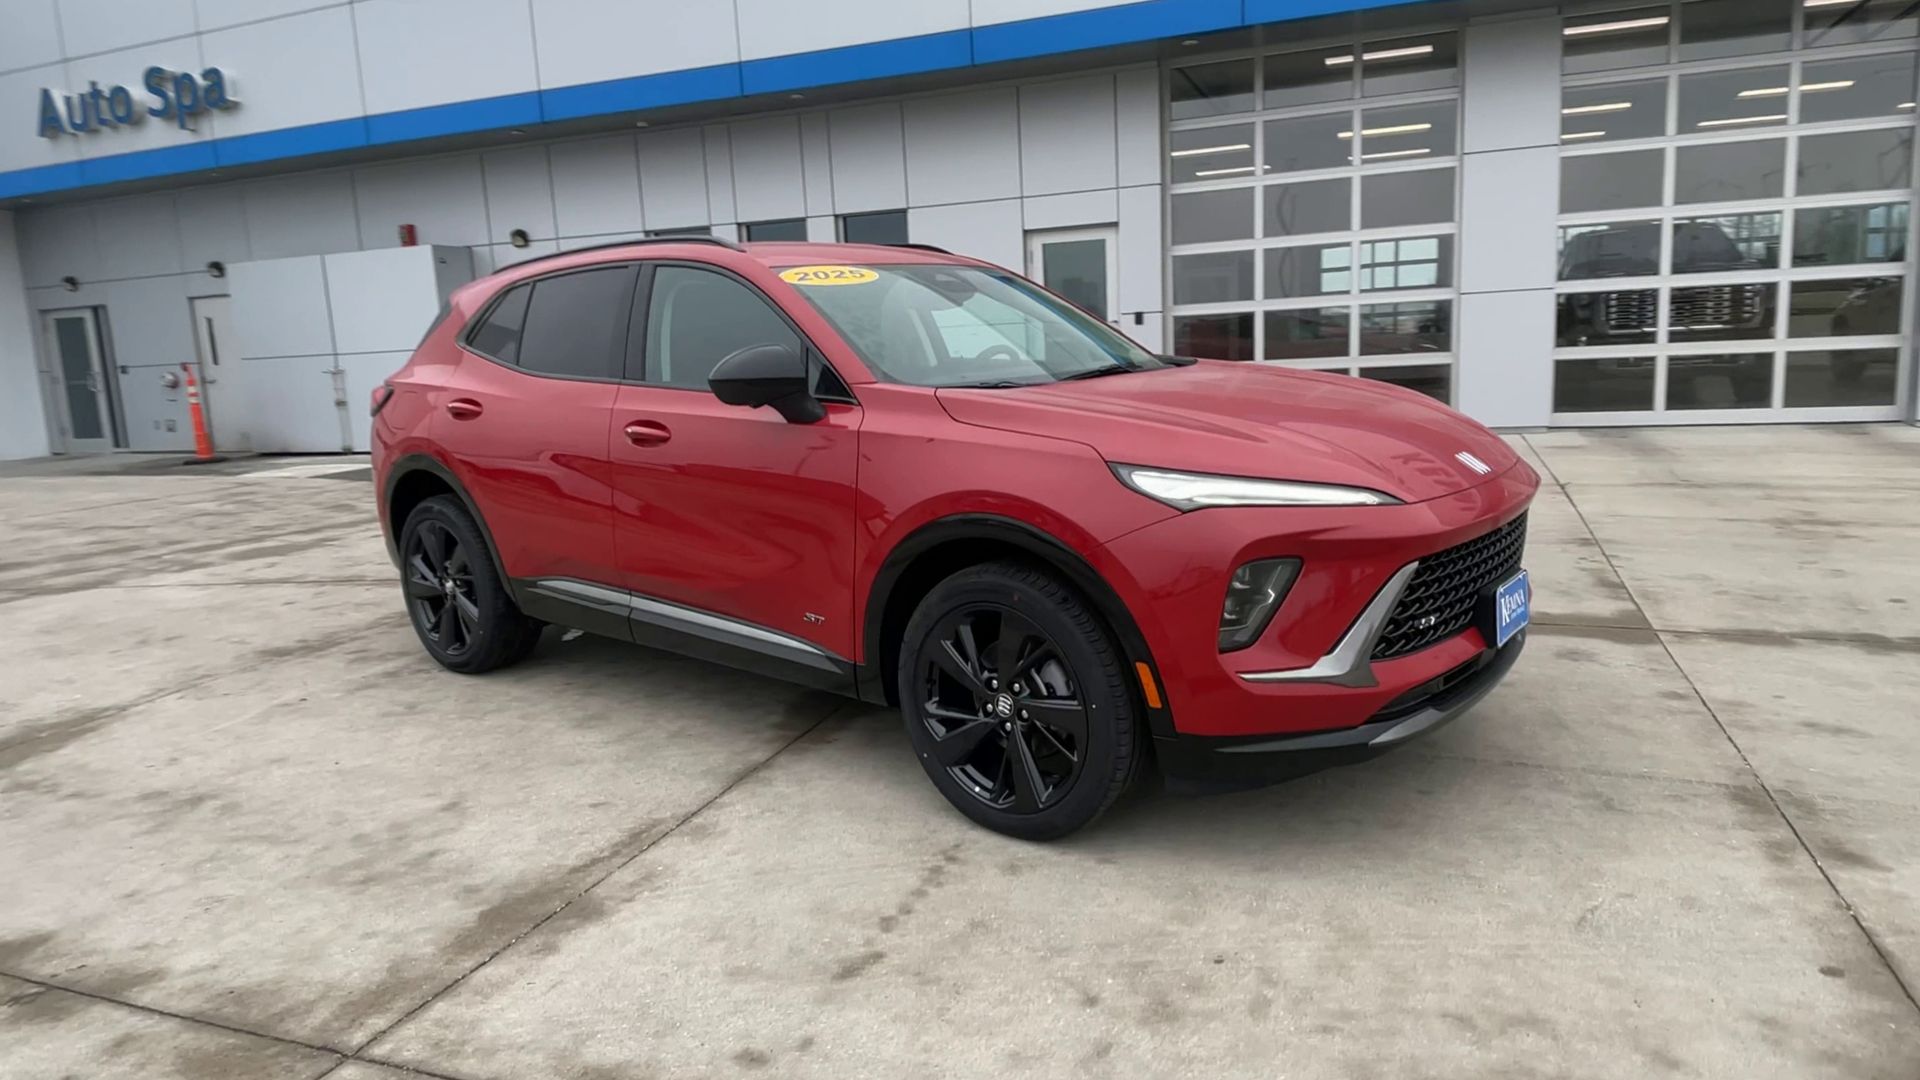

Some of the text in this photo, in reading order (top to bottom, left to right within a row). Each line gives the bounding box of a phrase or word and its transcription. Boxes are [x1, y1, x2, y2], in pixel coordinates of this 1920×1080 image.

[37, 65, 230, 139] Auto Spa
[793, 269, 866, 282] 2025
[803, 612, 825, 625] ST
